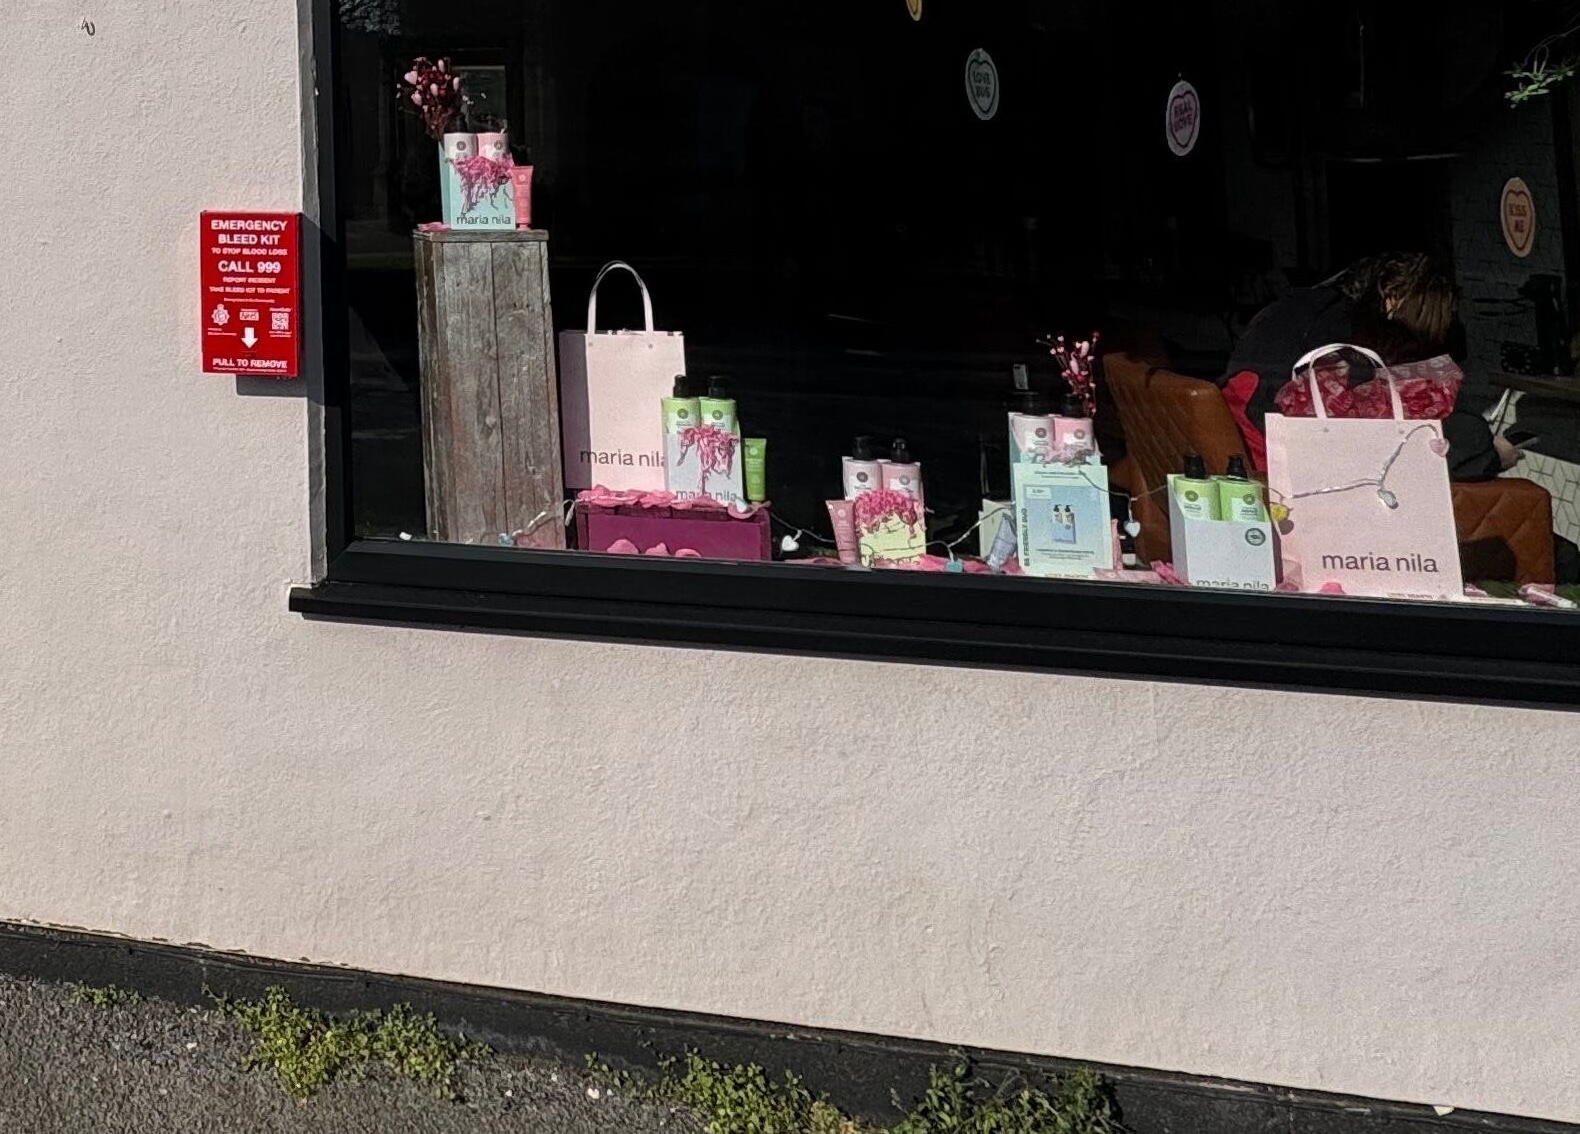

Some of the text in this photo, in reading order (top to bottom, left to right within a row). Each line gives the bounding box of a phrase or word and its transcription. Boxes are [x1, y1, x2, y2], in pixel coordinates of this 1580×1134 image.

[210, 219, 288, 231] EMERGENCY
[456, 214, 511, 225] maria nila
[217, 233, 281, 245] BLEED KIT
[222, 247, 241, 255] STOP
[218, 260, 281, 274] CALL 999
[212, 358, 288, 368] PULL TO REMOVE
[579, 448, 633, 466] maria
[1321, 551, 1439, 573] maria nila
